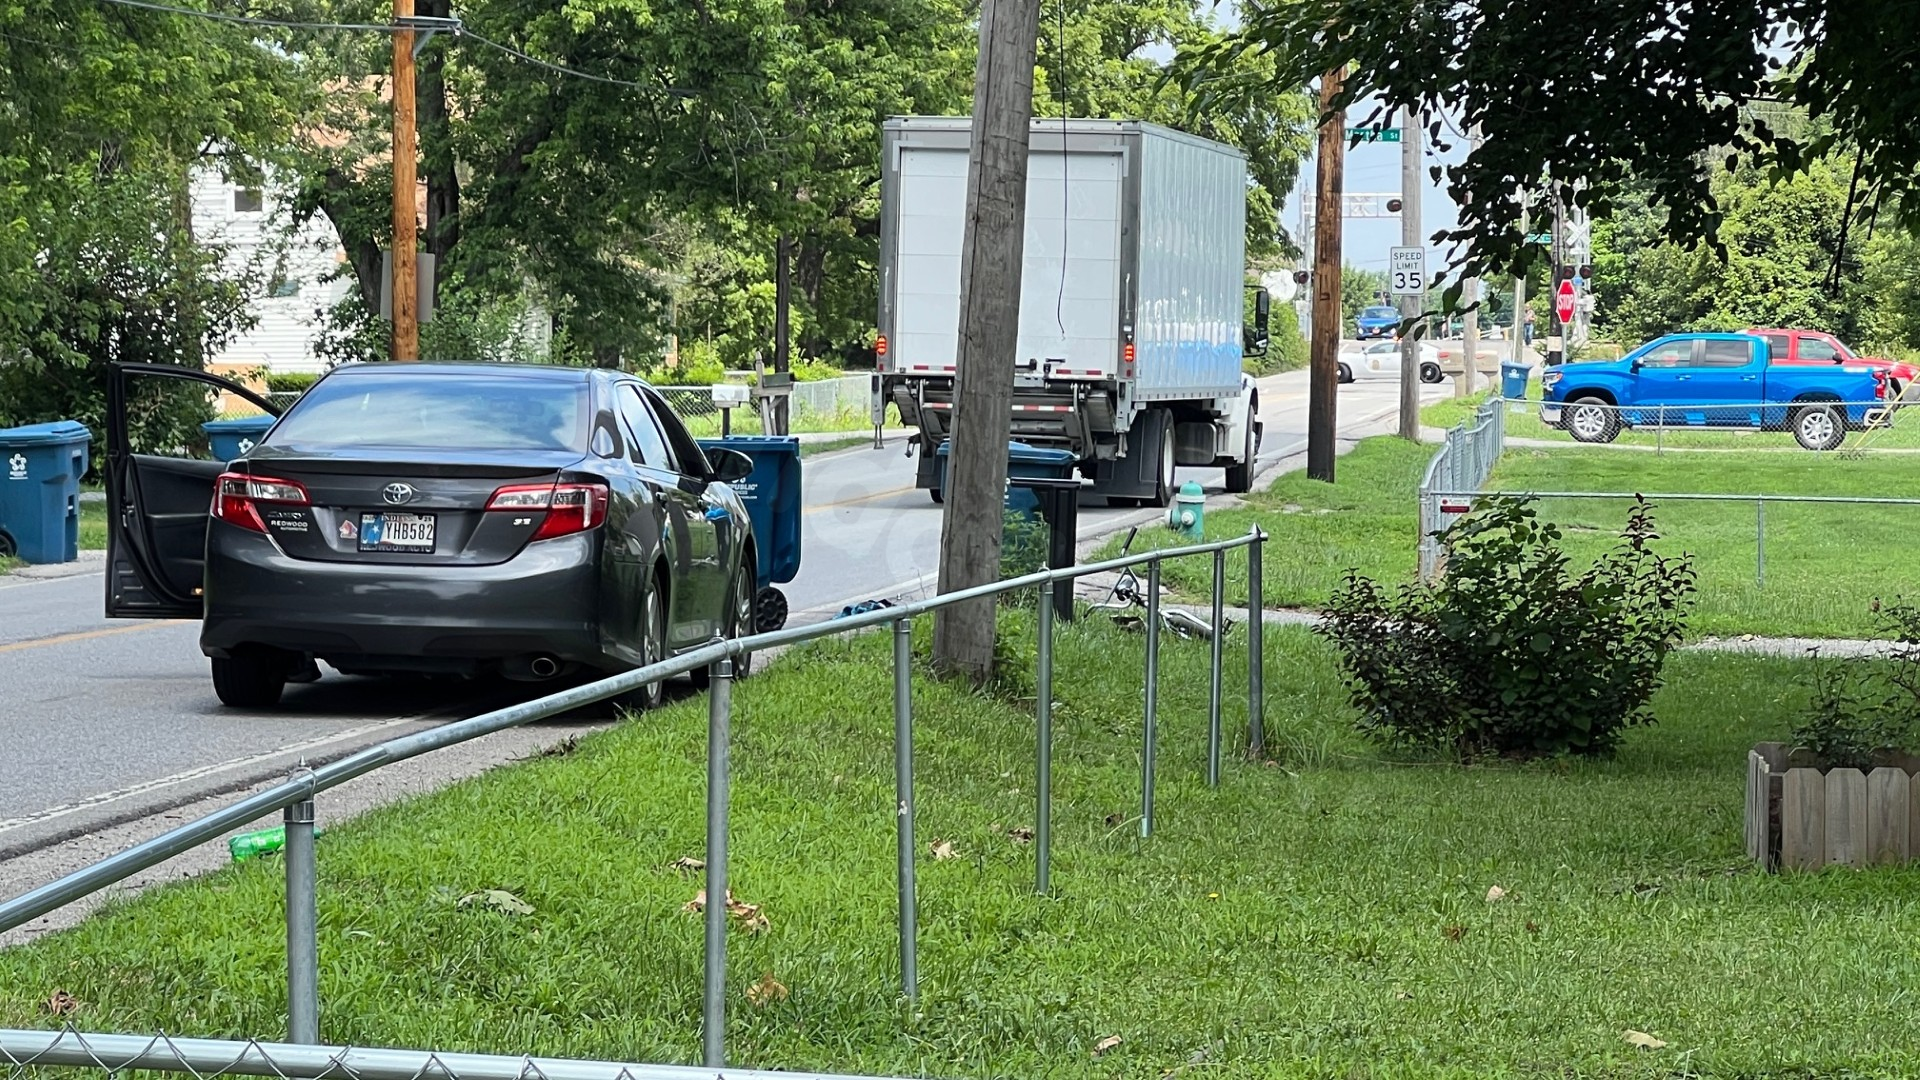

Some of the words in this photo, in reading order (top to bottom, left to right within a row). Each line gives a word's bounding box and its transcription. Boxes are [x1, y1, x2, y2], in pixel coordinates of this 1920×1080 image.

[1345, 130, 1384, 141] Mtha
[1393, 252, 1422, 260] SPEED
[1396, 262, 1418, 270] LIMIT
[1395, 272, 1421, 289] 35
[1558, 294, 1574, 310] STOP
[386, 523, 434, 541] YHB582
